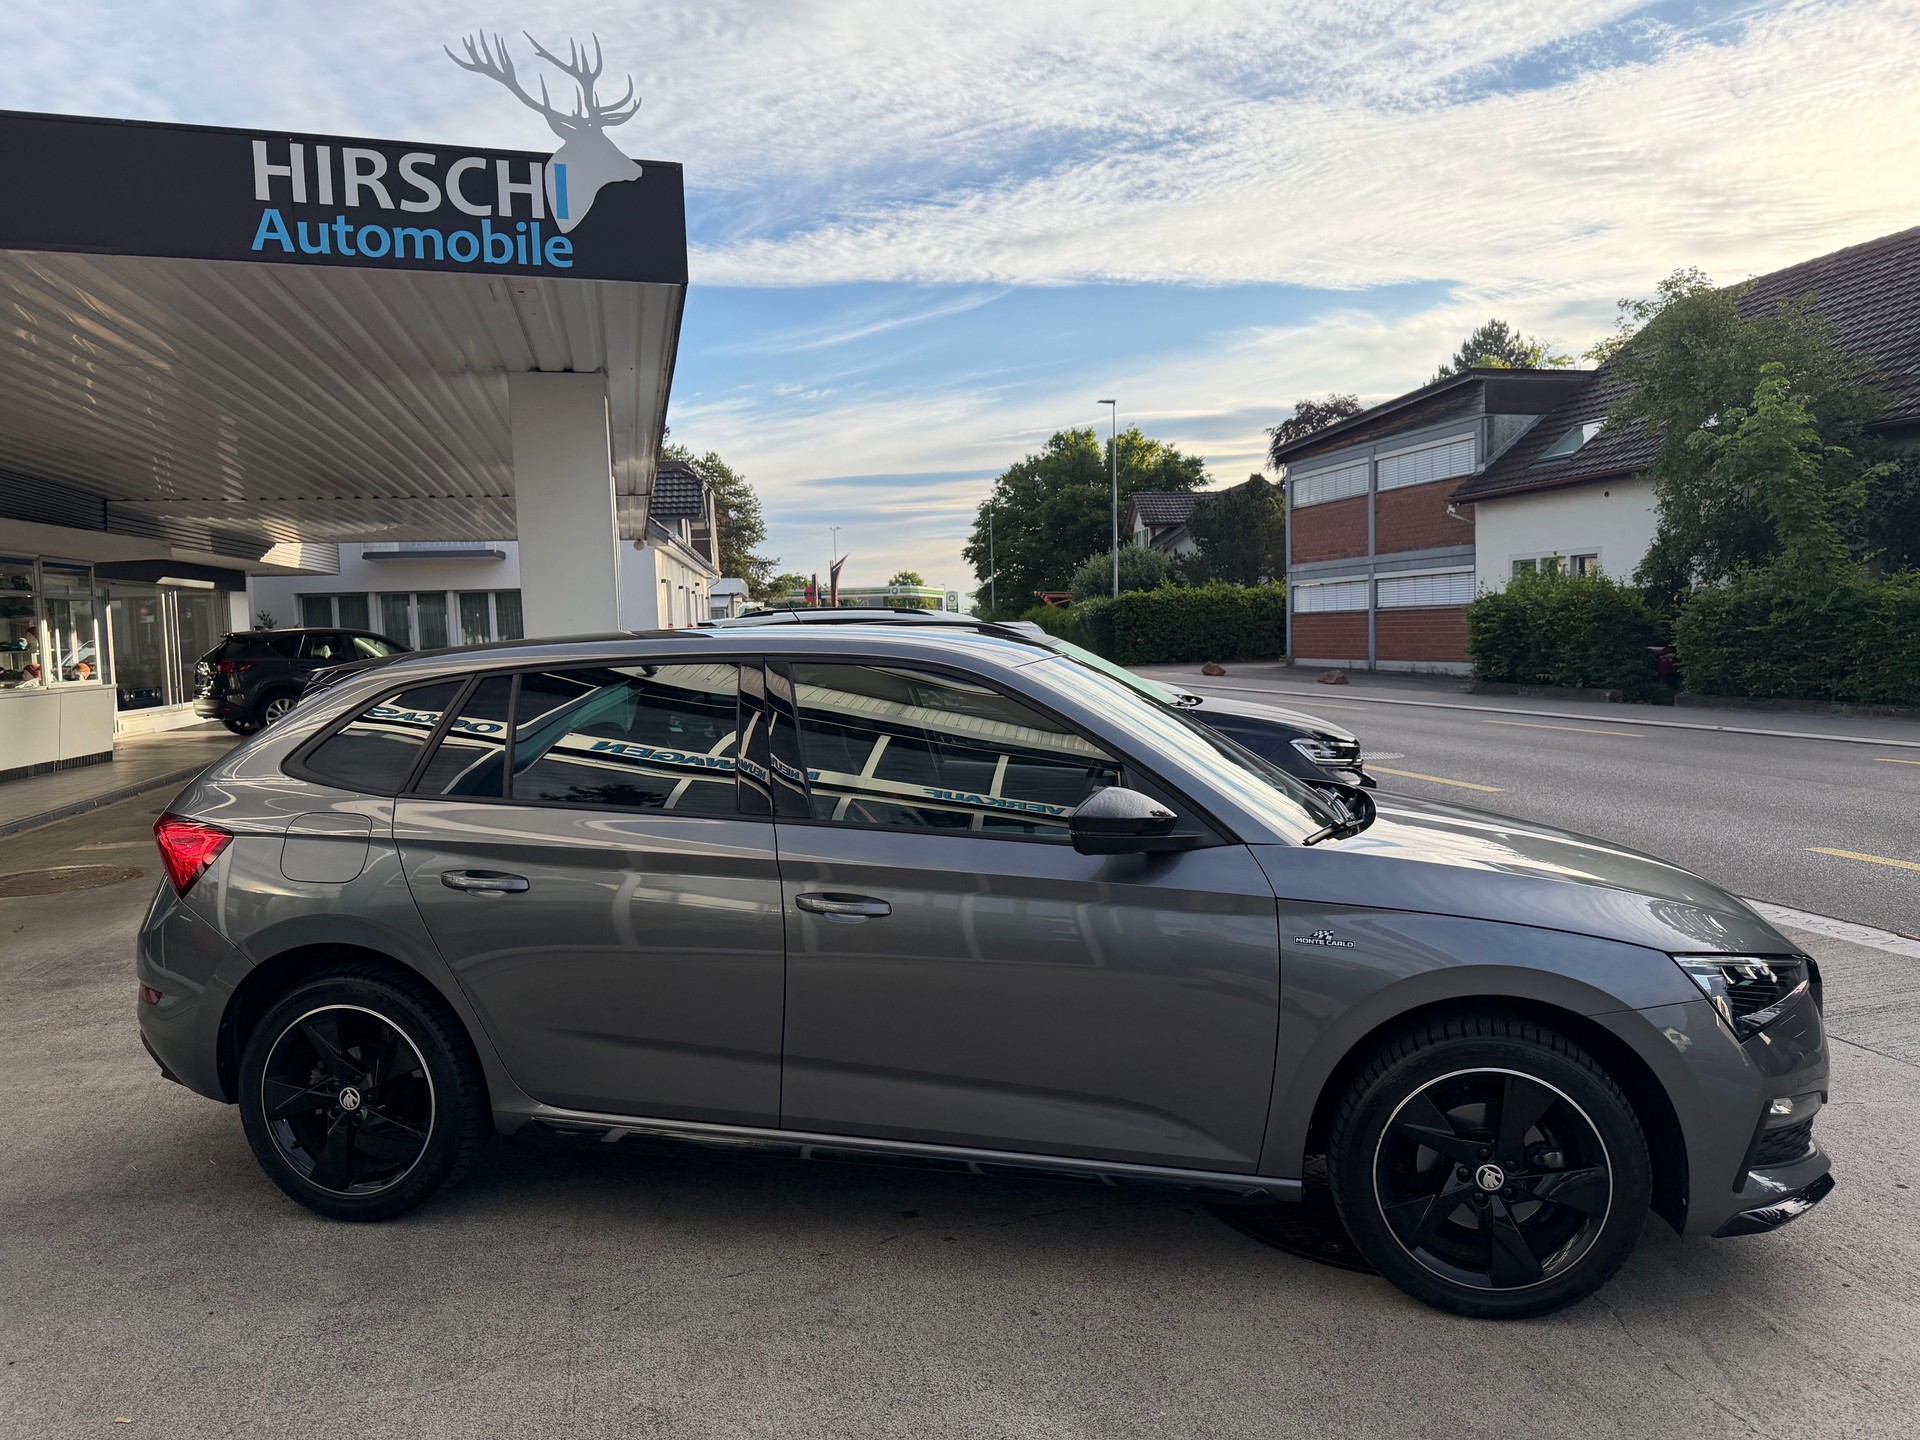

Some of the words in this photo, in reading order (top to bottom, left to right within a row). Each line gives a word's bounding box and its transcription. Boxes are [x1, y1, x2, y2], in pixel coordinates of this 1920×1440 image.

[251, 207, 574, 268] Automobile
[1295, 937, 1325, 946] MONTE
[1326, 940, 1354, 948] CARLO
